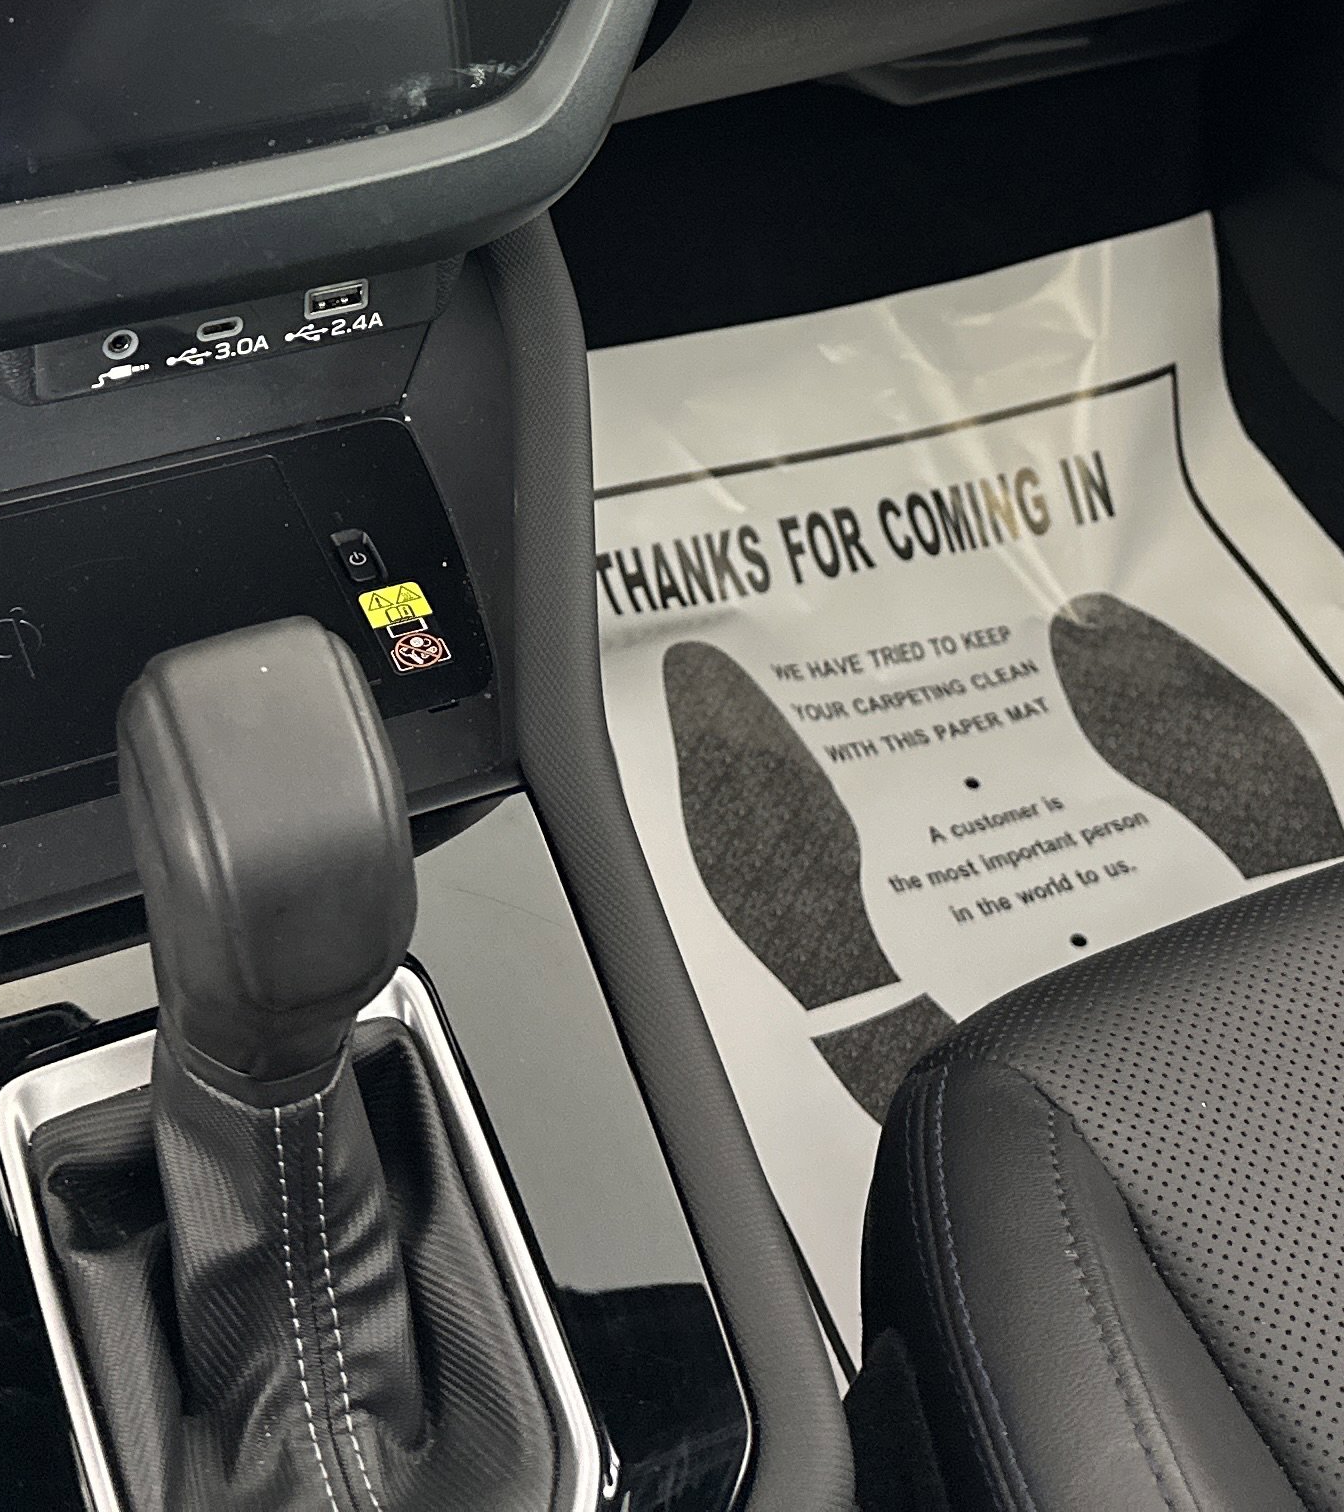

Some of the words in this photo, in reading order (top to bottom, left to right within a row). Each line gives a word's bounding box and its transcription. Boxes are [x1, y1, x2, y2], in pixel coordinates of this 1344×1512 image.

[215, 335, 269, 360] 3.0A
[331, 312, 384, 336] 2.4A
[596, 524, 771, 616] THANKS
[777, 506, 876, 585] FOR
[878, 467, 1052, 562] COMING
[1060, 450, 1115, 526] IN
[771, 663, 805, 681] WE
[807, 653, 864, 679] HAVE
[867, 641, 926, 669] TRIED
[928, 635, 958, 657] TO
[960, 625, 1012, 651] KEEP
[790, 701, 850, 723] YOUR
[853, 678, 967, 716] CARPETING
[971, 659, 1041, 690] CLEAN
[823, 738, 879, 764] WITH
[881, 727, 930, 754] THIS
[933, 711, 1004, 742] PAPER
[1005, 696, 1050, 724] MAT
[928, 825, 947, 844] A
[950, 803, 1040, 838] customer
[1041, 796, 1065, 813] is
[888, 874, 923, 894] the
[925, 858, 981, 887] most
[979, 830, 1078, 869] important
[1080, 811, 1150, 846] person
[949, 904, 975, 924] in
[976, 896, 1013, 918] the
[1016, 873, 1074, 906] world
[1075, 868, 1100, 887] to
[1103, 859, 1138, 879] us.
